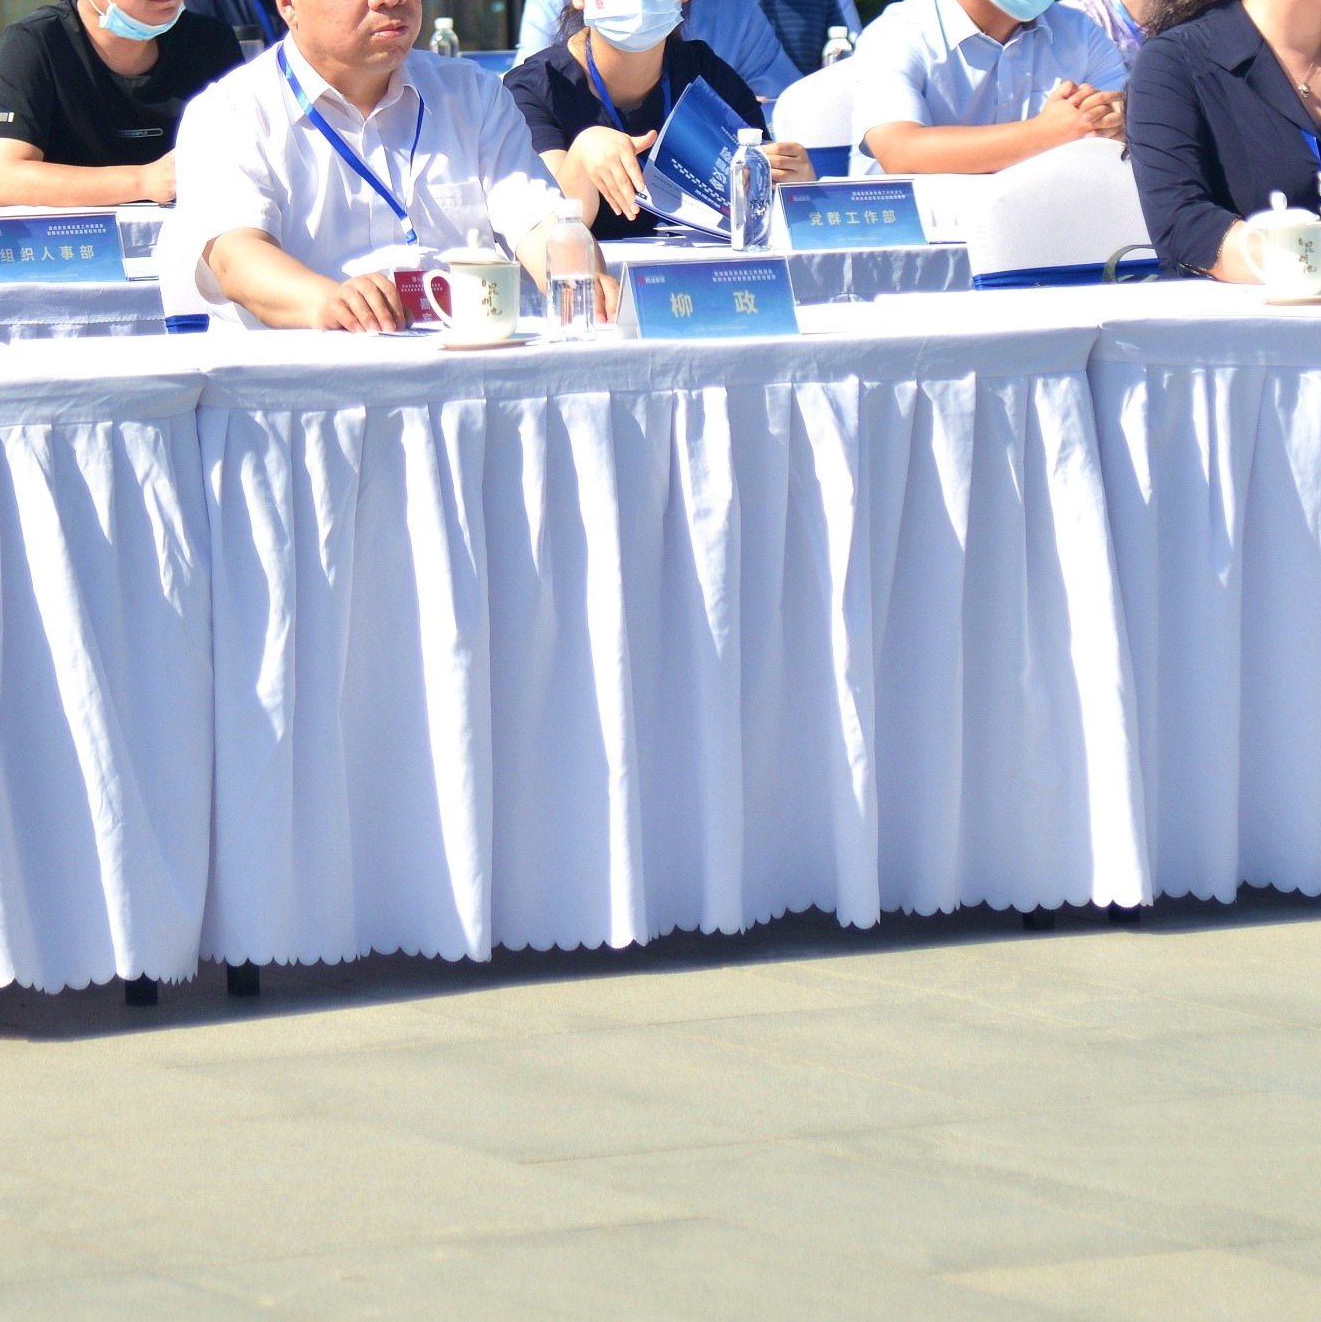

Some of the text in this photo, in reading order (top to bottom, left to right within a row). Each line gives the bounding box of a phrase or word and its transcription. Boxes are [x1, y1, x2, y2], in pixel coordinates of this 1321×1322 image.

[809, 210, 897, 226] 党群工作部
[0, 245, 95, 263] 组织人事部
[669, 290, 758, 318] 柳政
